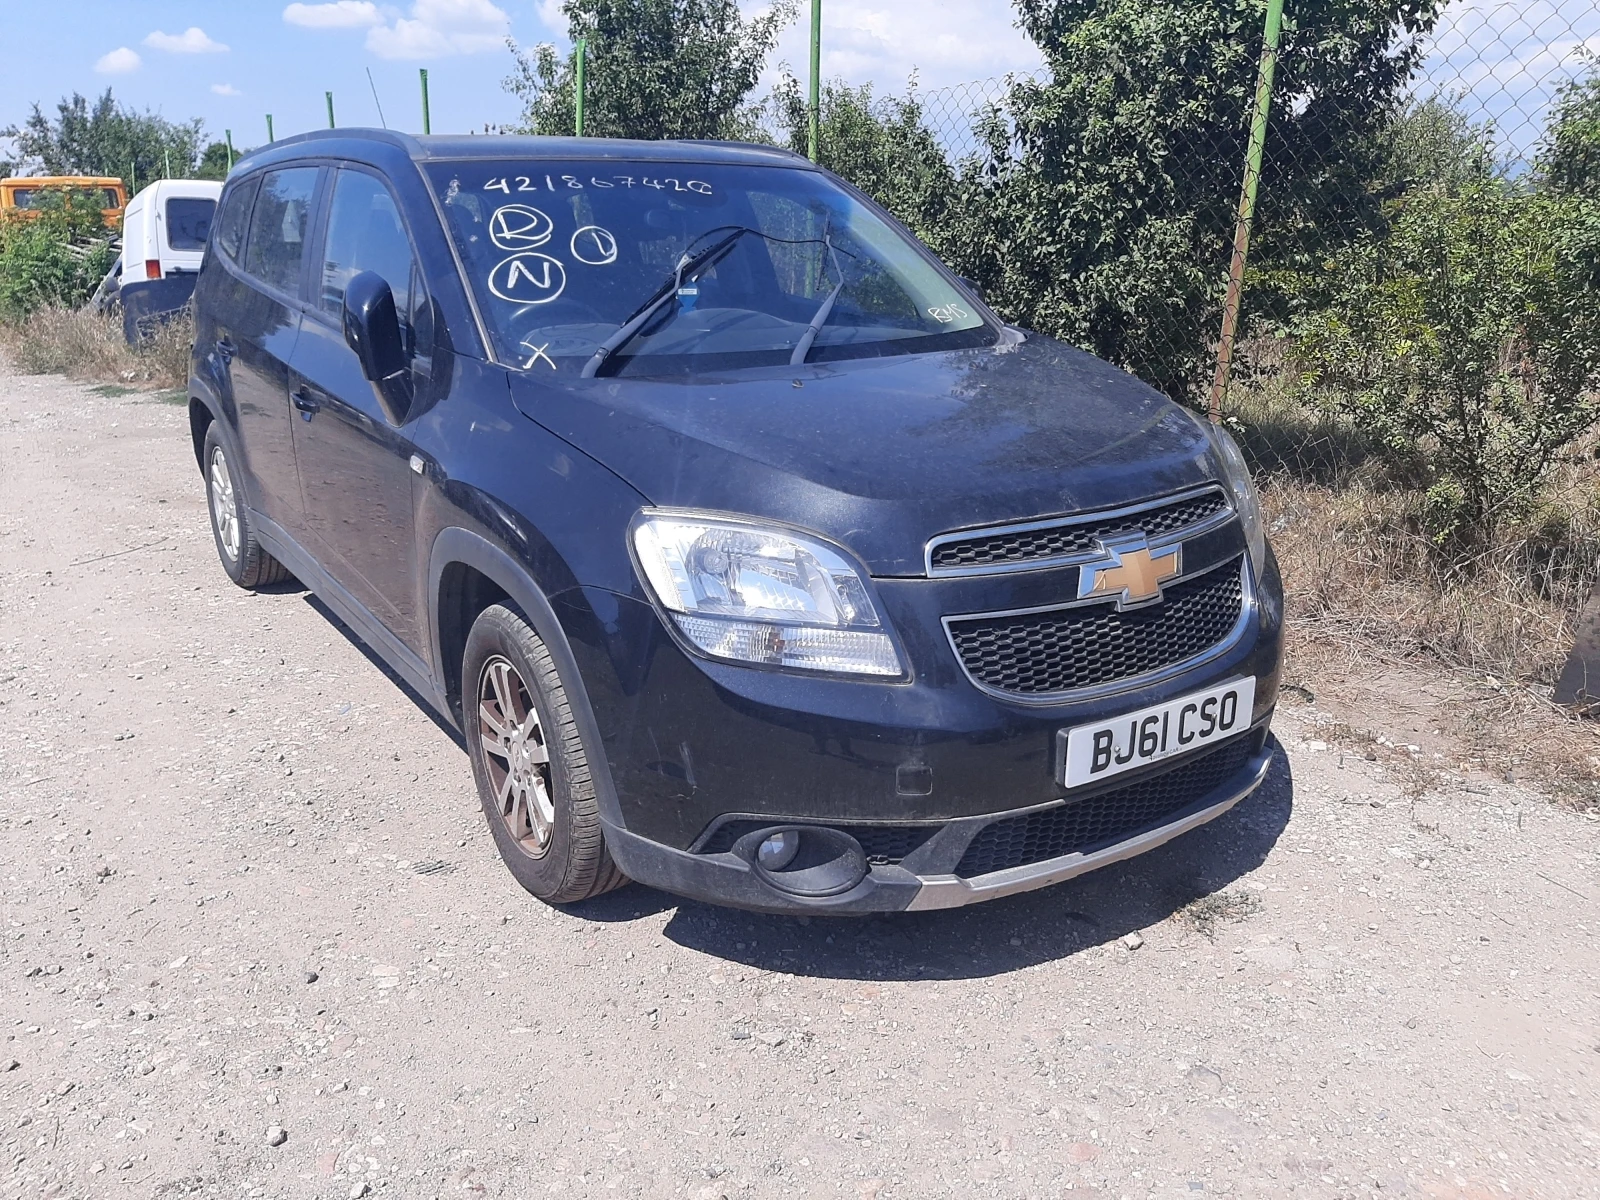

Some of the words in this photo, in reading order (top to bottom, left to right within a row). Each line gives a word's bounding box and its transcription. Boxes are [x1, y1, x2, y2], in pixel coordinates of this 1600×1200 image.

[507, 260, 551, 288] N
[1089, 710, 1170, 775] BJ61
[1177, 690, 1238, 746] CSO
